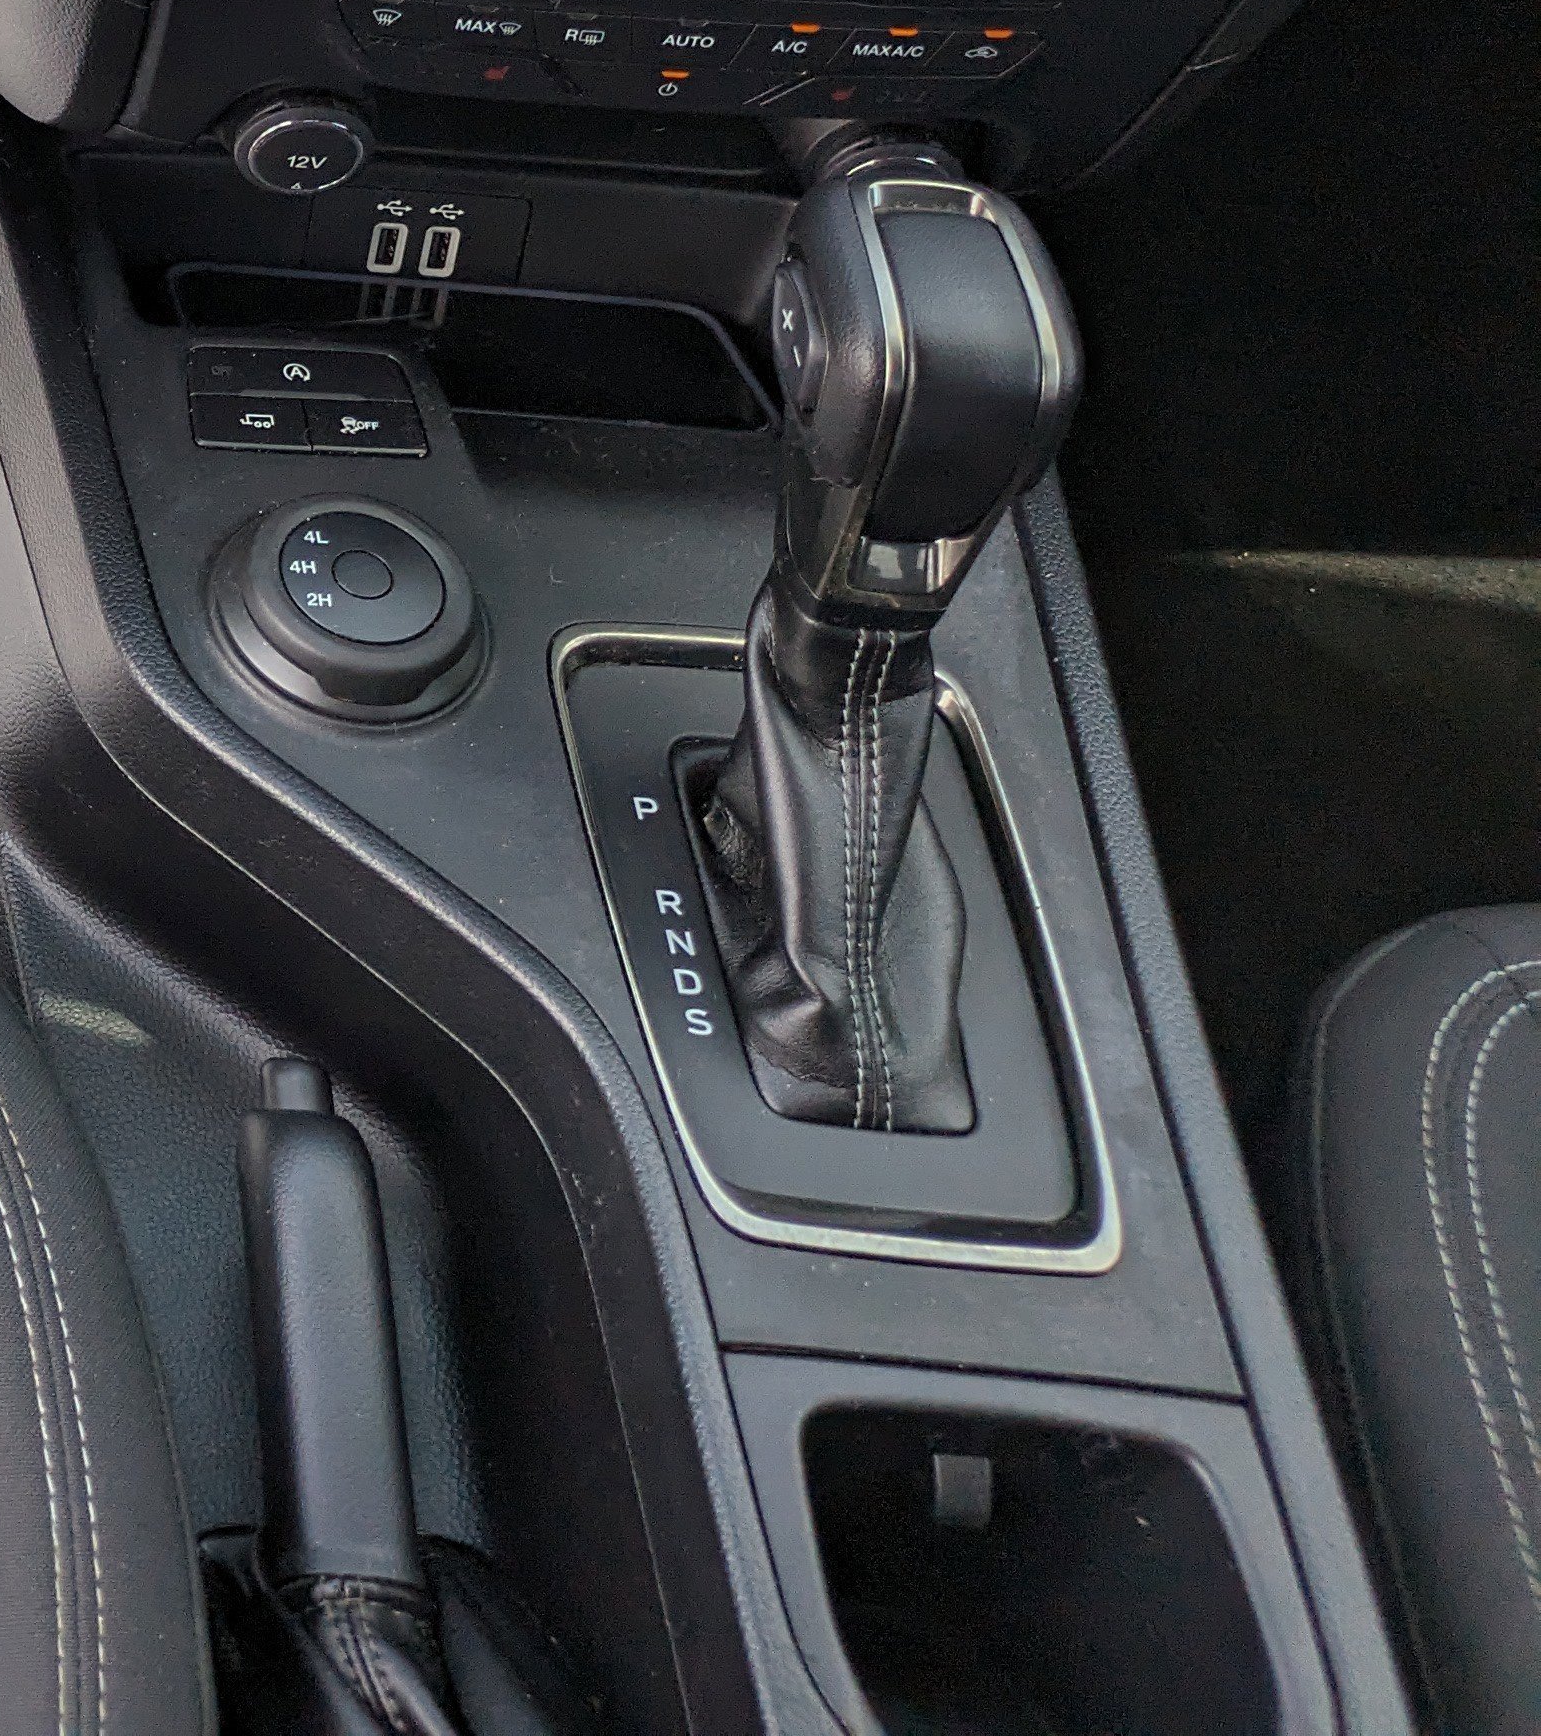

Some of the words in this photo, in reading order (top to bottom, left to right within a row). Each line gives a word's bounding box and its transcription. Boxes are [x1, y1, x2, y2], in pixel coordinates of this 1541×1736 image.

[455, 18, 499, 34] MAX
[662, 35, 715, 48] AUTO
[771, 40, 808, 54] A/C
[287, 154, 328, 170] 12V
[303, 530, 330, 545] 4L
[290, 560, 317, 574] 4H
[306, 592, 332, 608] 2H
[633, 796, 659, 820] P
[655, 889, 683, 915] R
[665, 929, 697, 956] N
[673, 968, 703, 995] D
[685, 1008, 713, 1036] S
